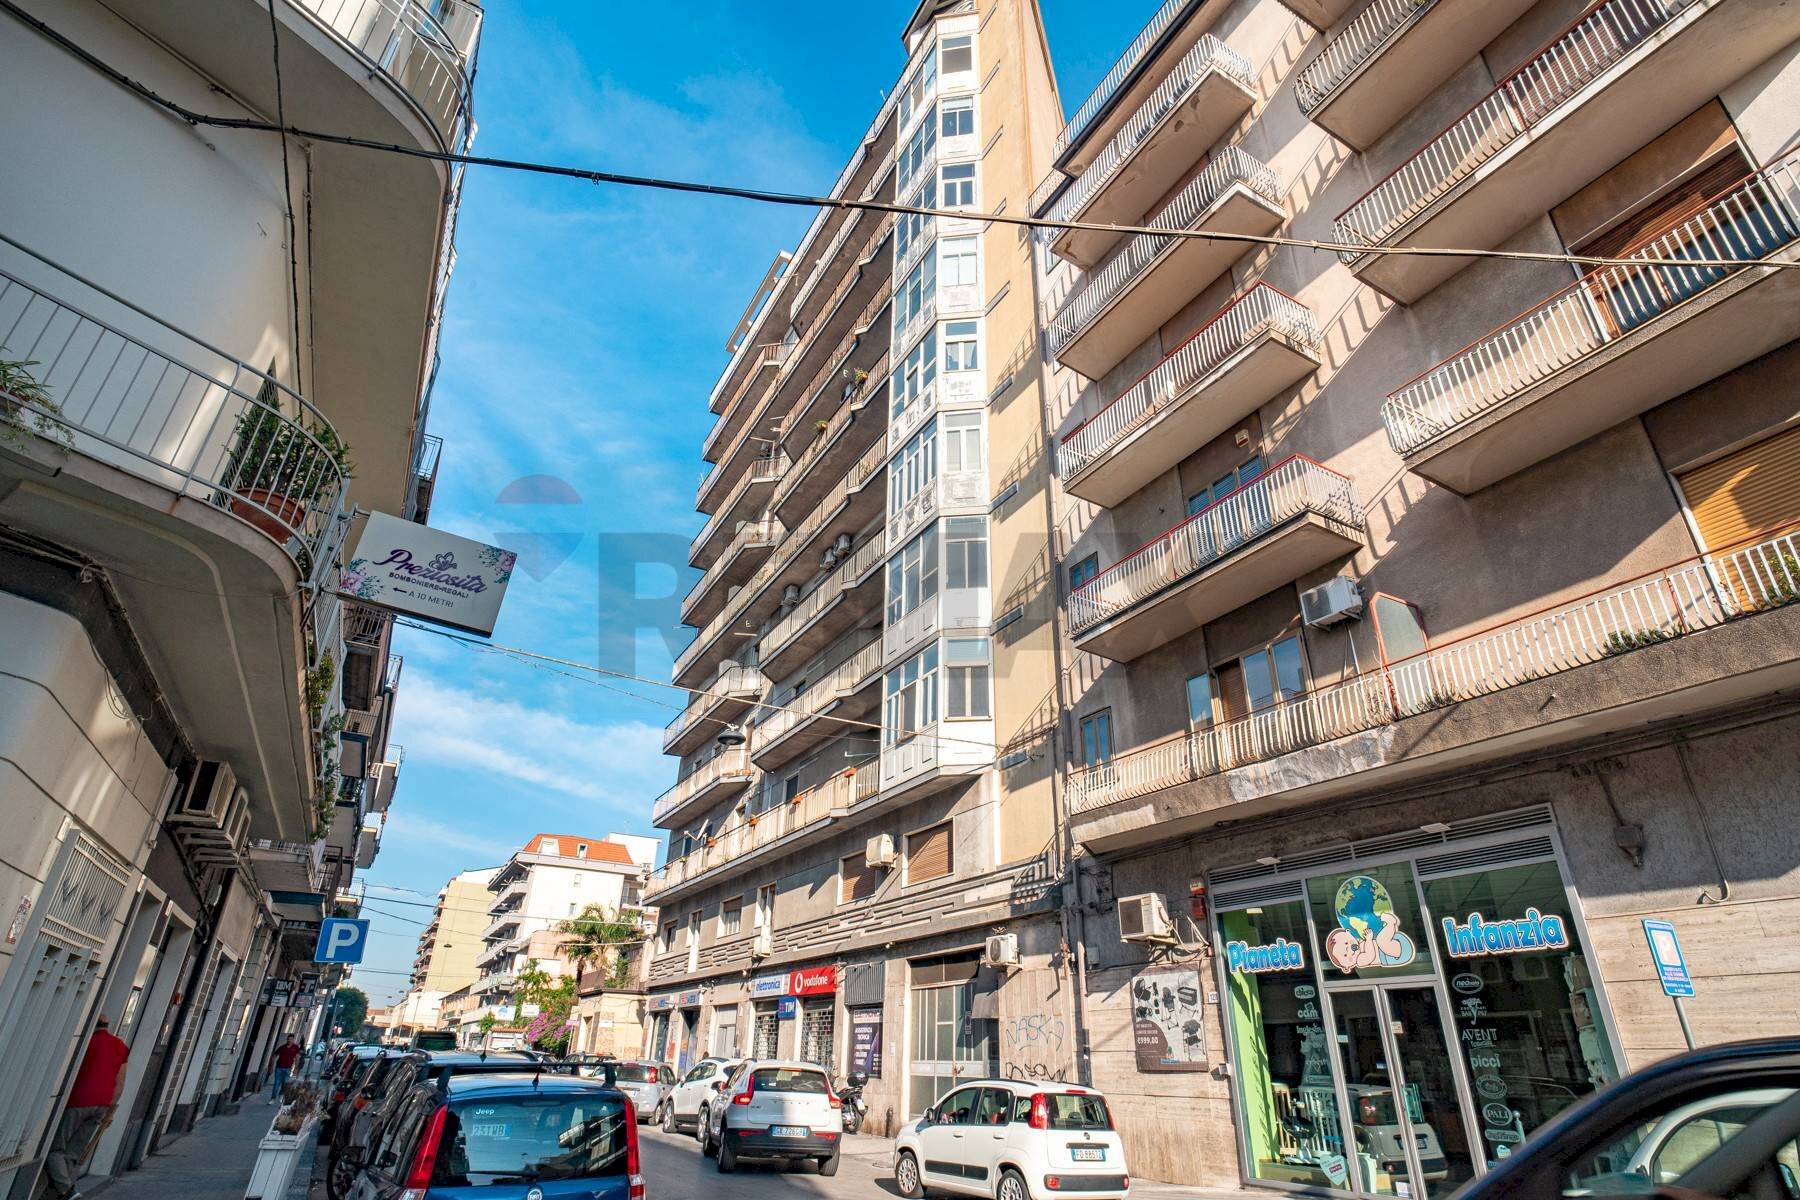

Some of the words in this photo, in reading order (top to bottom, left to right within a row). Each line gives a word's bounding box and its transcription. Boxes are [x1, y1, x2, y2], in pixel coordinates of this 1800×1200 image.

[428, 596, 454, 608] METRI
[1442, 907, 1569, 957] Infanzia
[326, 923, 359, 958] P
[1227, 938, 1304, 974] Pianeta
[803, 974, 829, 987] vodafone
[785, 1001, 795, 1013] TIM
[1462, 1028, 1498, 1041] AVENT
[1470, 1053, 1501, 1069] picci
[1487, 1109, 1509, 1120] PALI
